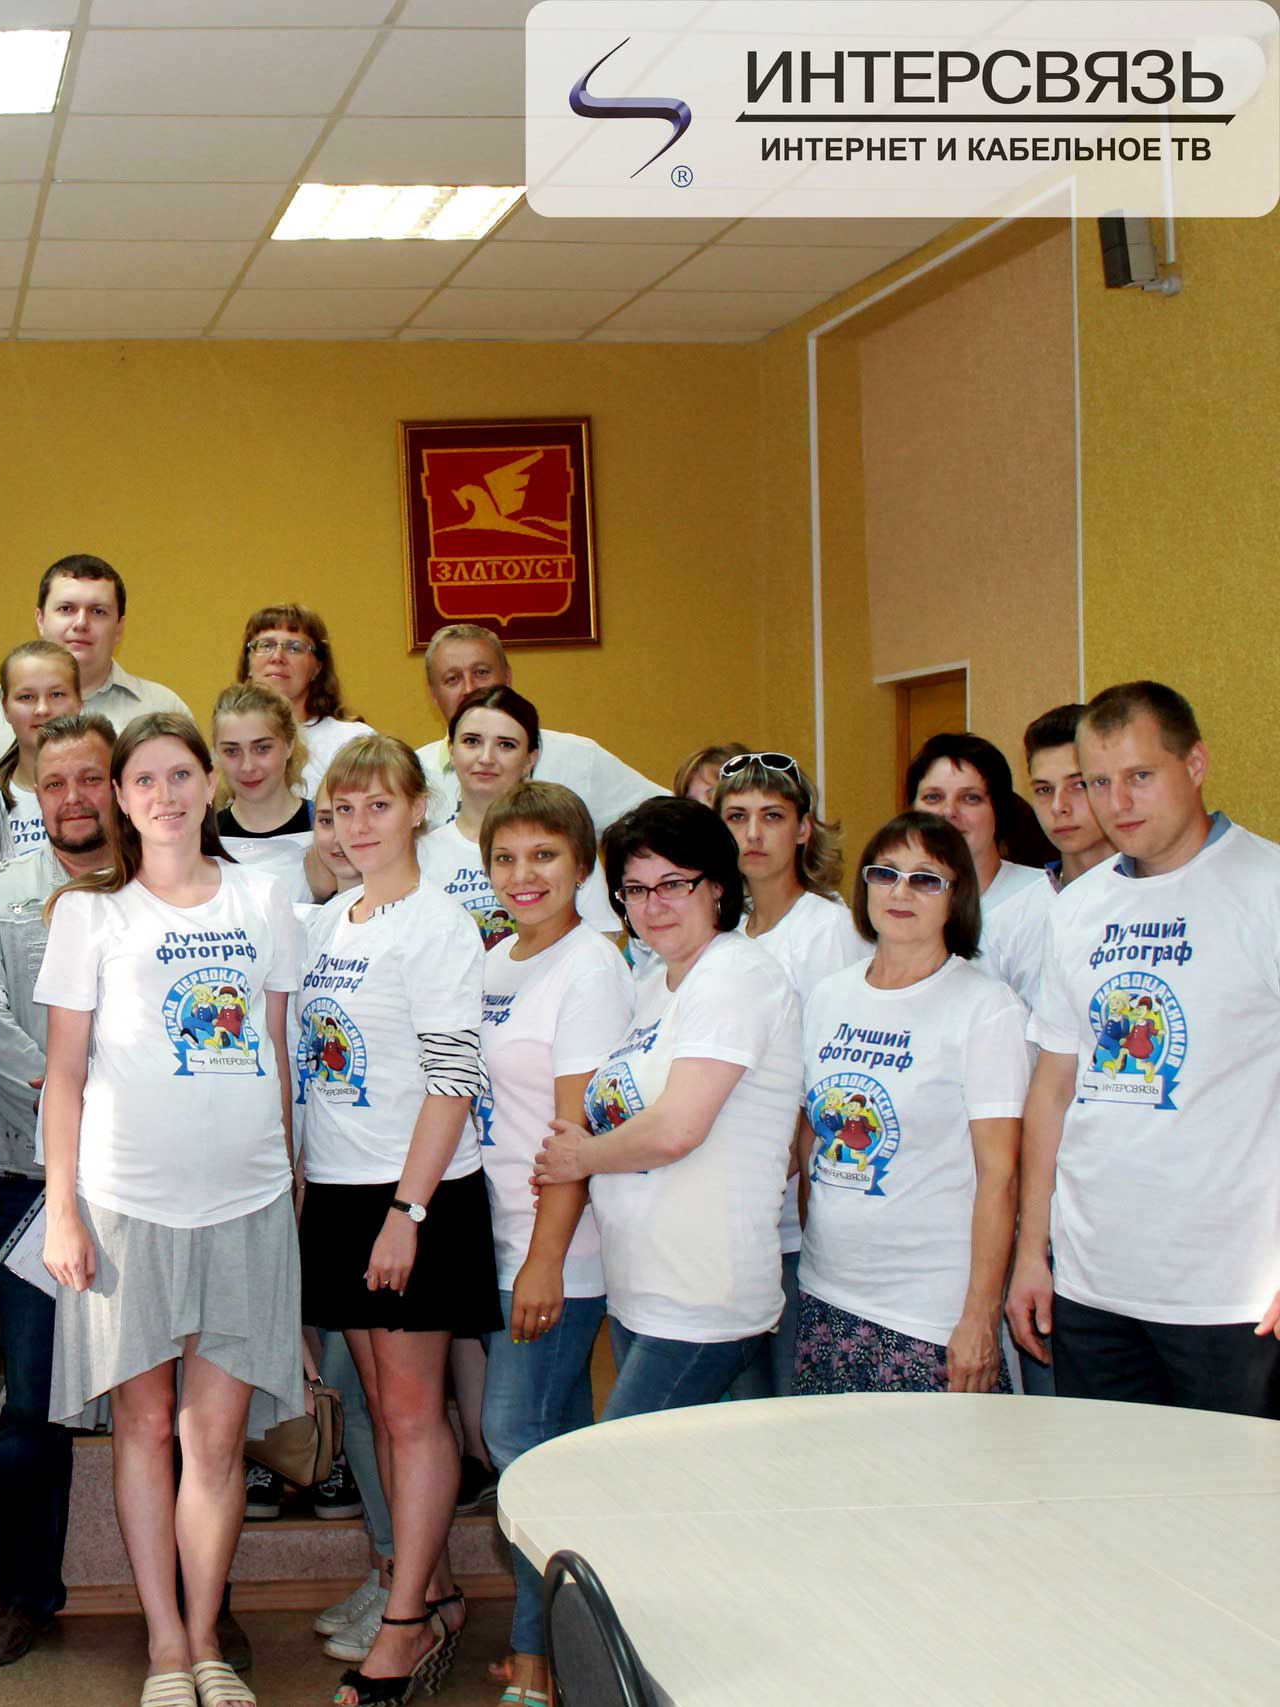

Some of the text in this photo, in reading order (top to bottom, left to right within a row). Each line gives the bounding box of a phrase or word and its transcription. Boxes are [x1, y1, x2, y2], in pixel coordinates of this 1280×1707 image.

[436, 559, 568, 581] ЗЛАТОУСТ
[164, 927, 248, 947] Лучший
[1103, 916, 1187, 945] Лучший
[156, 942, 257, 964] фотограф
[315, 953, 370, 974] Лучший
[1089, 940, 1193, 970] фотограф
[303, 970, 364, 993] фотограф
[834, 1023, 912, 1049] Лучший
[819, 1042, 914, 1073] фотограф
